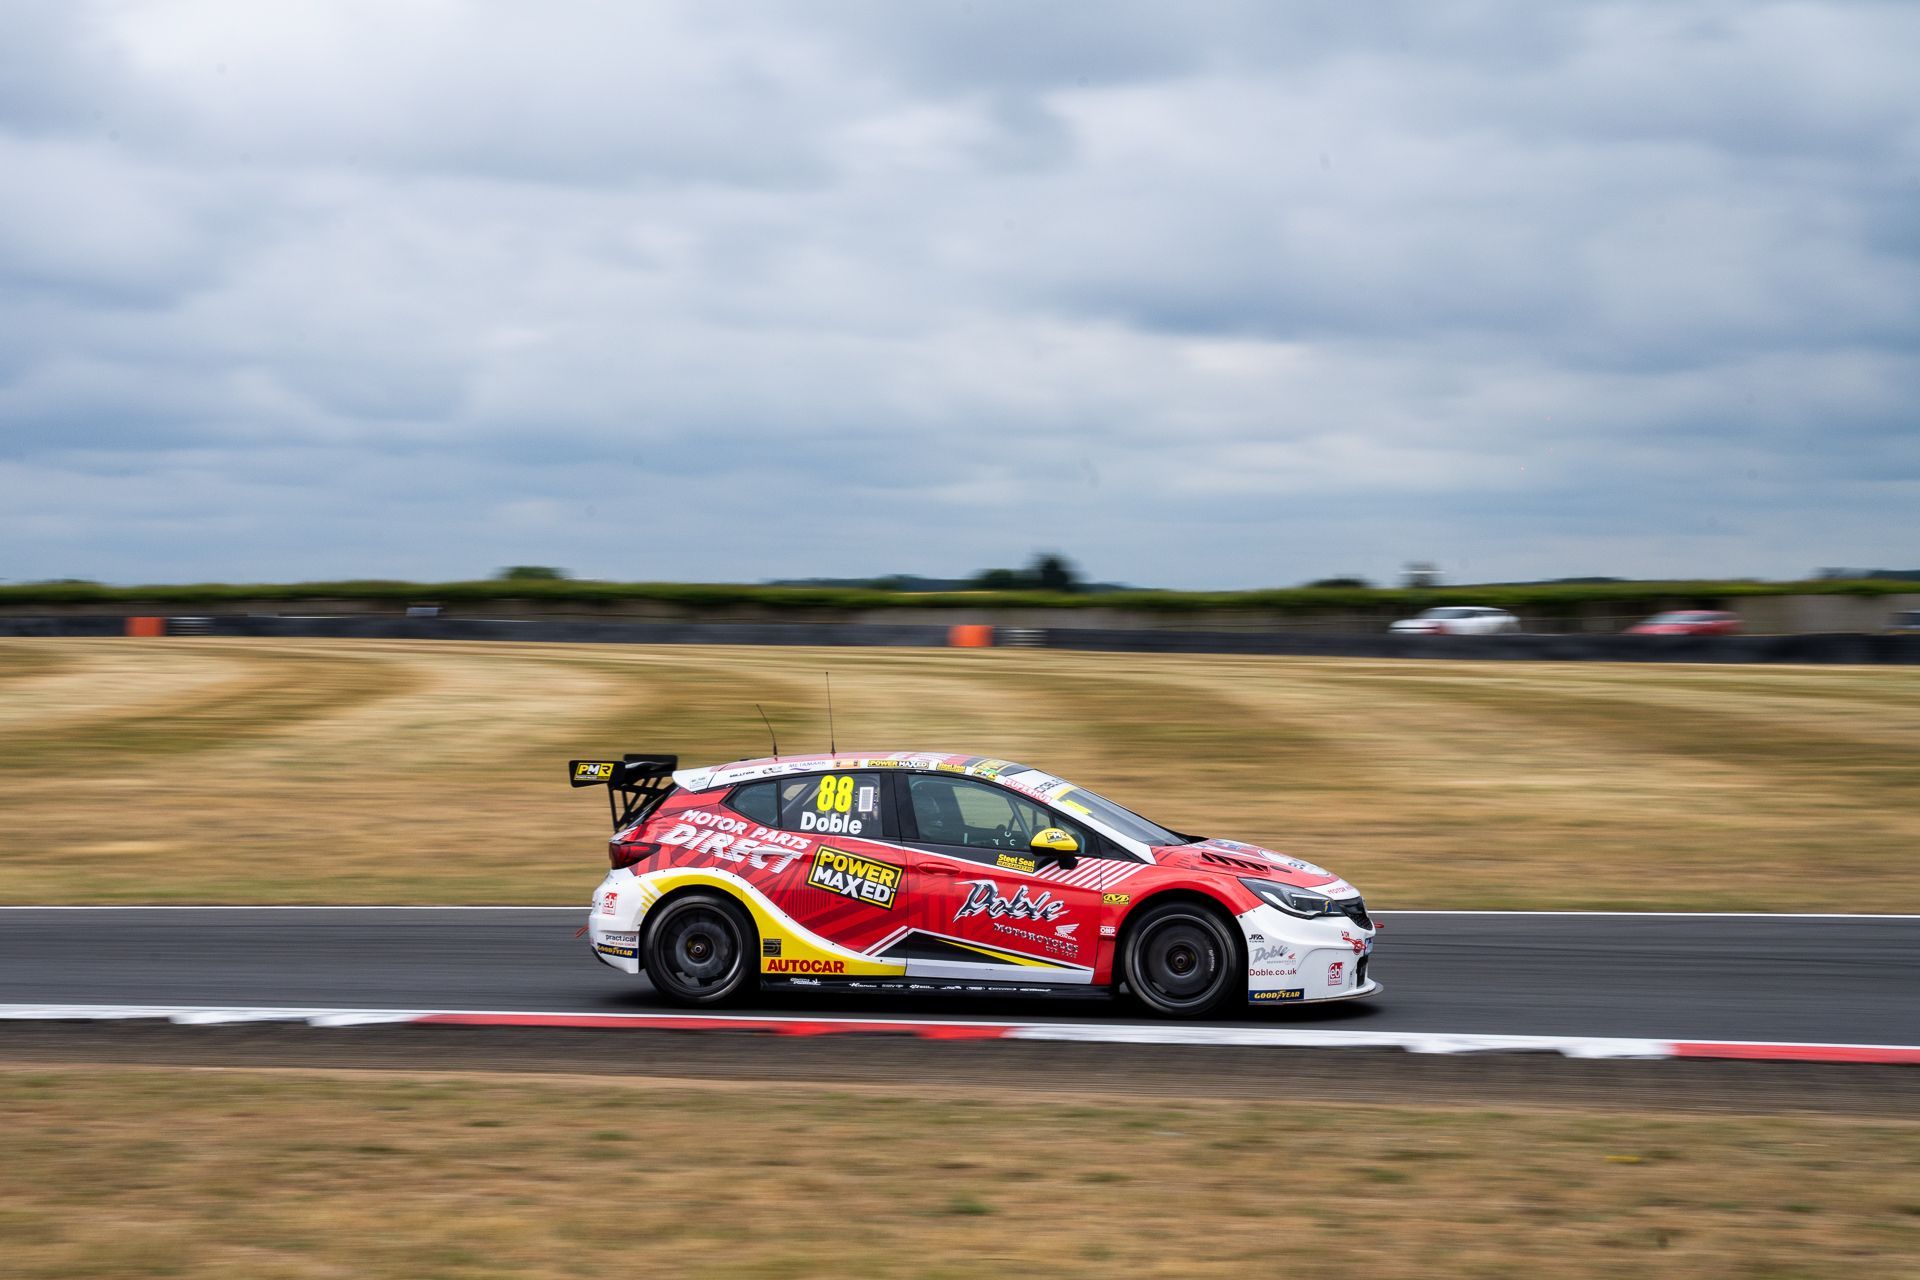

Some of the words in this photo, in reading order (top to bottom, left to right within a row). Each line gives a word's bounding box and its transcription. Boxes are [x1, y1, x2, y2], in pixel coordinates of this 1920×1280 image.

[577, 763, 611, 775] PMR
[899, 760, 928, 769] MAXED
[817, 774, 855, 813] 88
[678, 809, 748, 835] MOTOR
[751, 826, 812, 850] PARTS
[800, 811, 862, 835] Doble
[656, 823, 804, 874] DIRECT
[818, 850, 895, 887] POWER
[998, 853, 1018, 863] Steel
[1018, 857, 1035, 868] Seal
[813, 866, 891, 902] MAXED
[953, 879, 1071, 923] Doble
[993, 922, 1079, 953] MOTORCYCLES
[597, 946, 633, 957] GOODYEAR
[1250, 945, 1289, 965] Doble
[767, 959, 845, 973] AUTOCAR
[1249, 968, 1297, 976] Doble.co.uk
[1254, 991, 1301, 999] GOODYEAR
